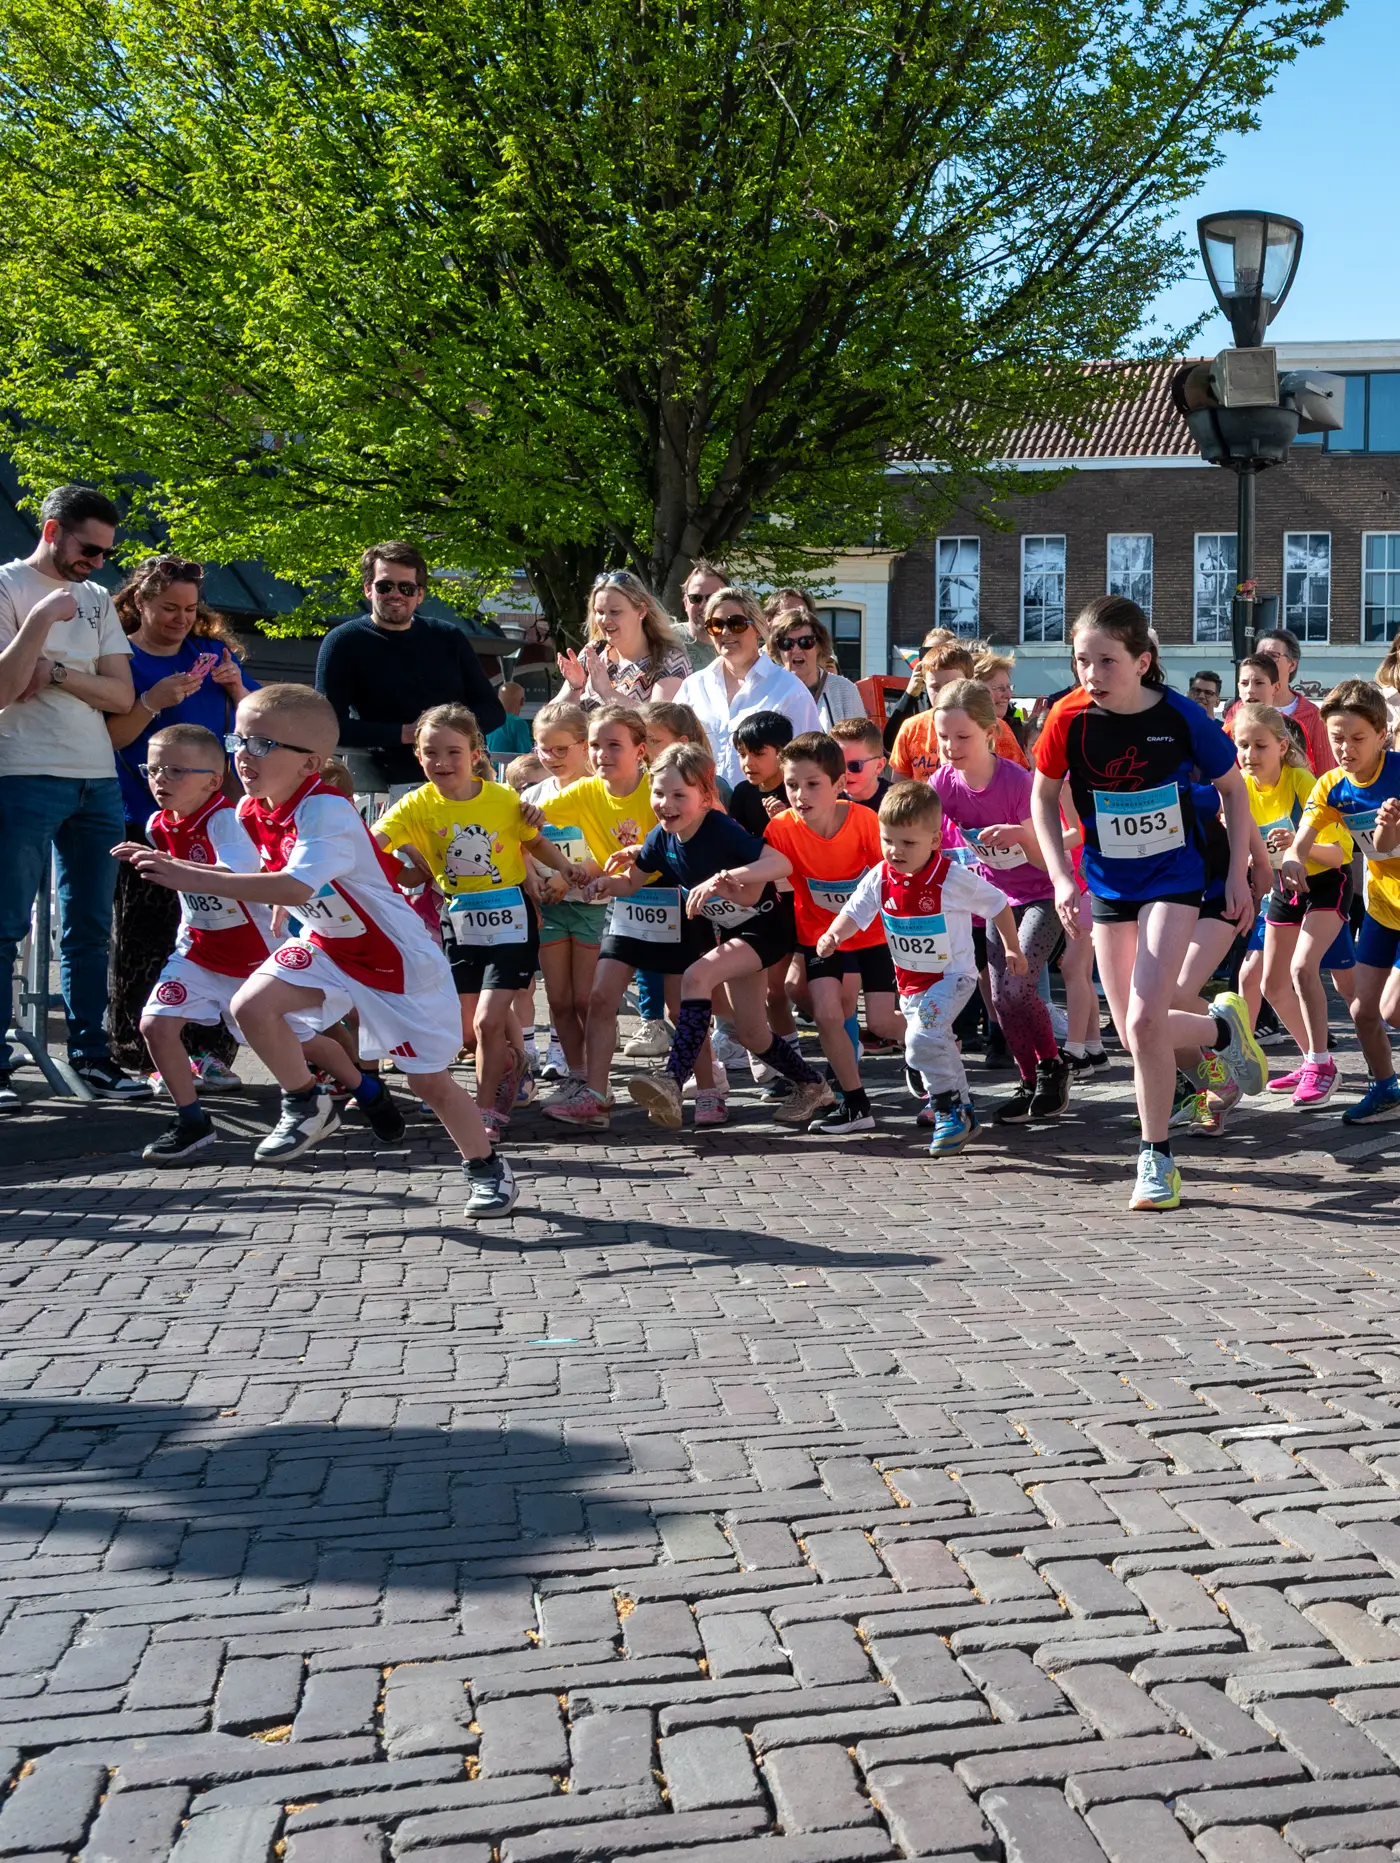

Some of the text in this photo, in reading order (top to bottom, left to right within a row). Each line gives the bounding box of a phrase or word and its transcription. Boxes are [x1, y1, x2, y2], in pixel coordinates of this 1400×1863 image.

[1110, 812, 1167, 836] 1053
[183, 893, 222, 911] 1083
[295, 899, 333, 918] 081
[702, 900, 735, 917] 1096
[464, 909, 513, 927] 1068
[626, 905, 667, 924] 1069
[890, 934, 936, 954] 1082
